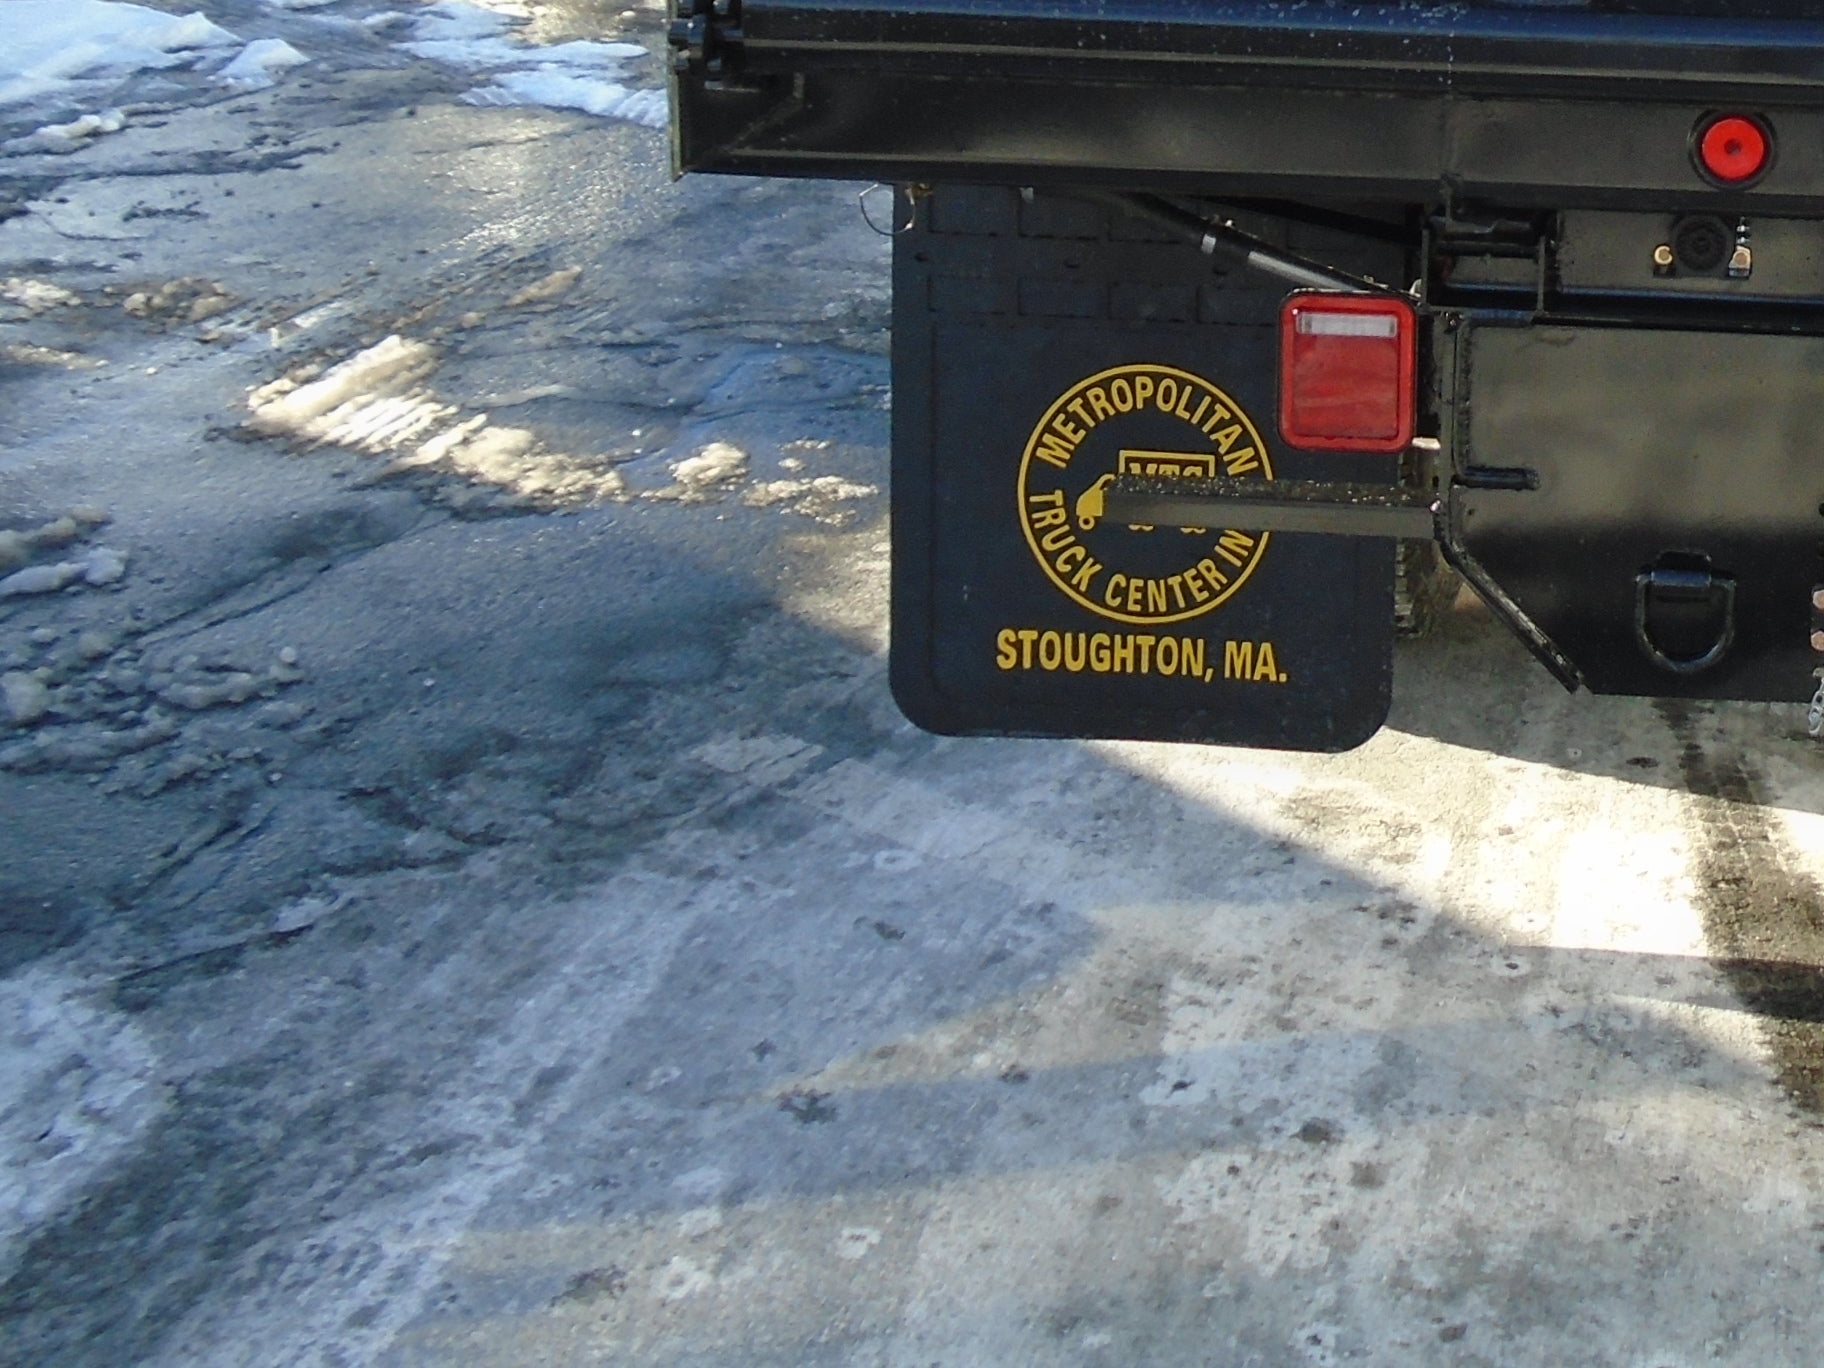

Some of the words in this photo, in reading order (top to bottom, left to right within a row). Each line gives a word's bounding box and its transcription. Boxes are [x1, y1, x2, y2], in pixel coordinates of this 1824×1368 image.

[1036, 375, 1259, 476] METROPOLITAN
[1029, 489, 1103, 593] TRUCK
[1105, 558, 1228, 613] CENTER
[1214, 528, 1255, 568] IN
[996, 628, 1215, 683] STOUGHTON,
[1224, 640, 1288, 683] MA.
